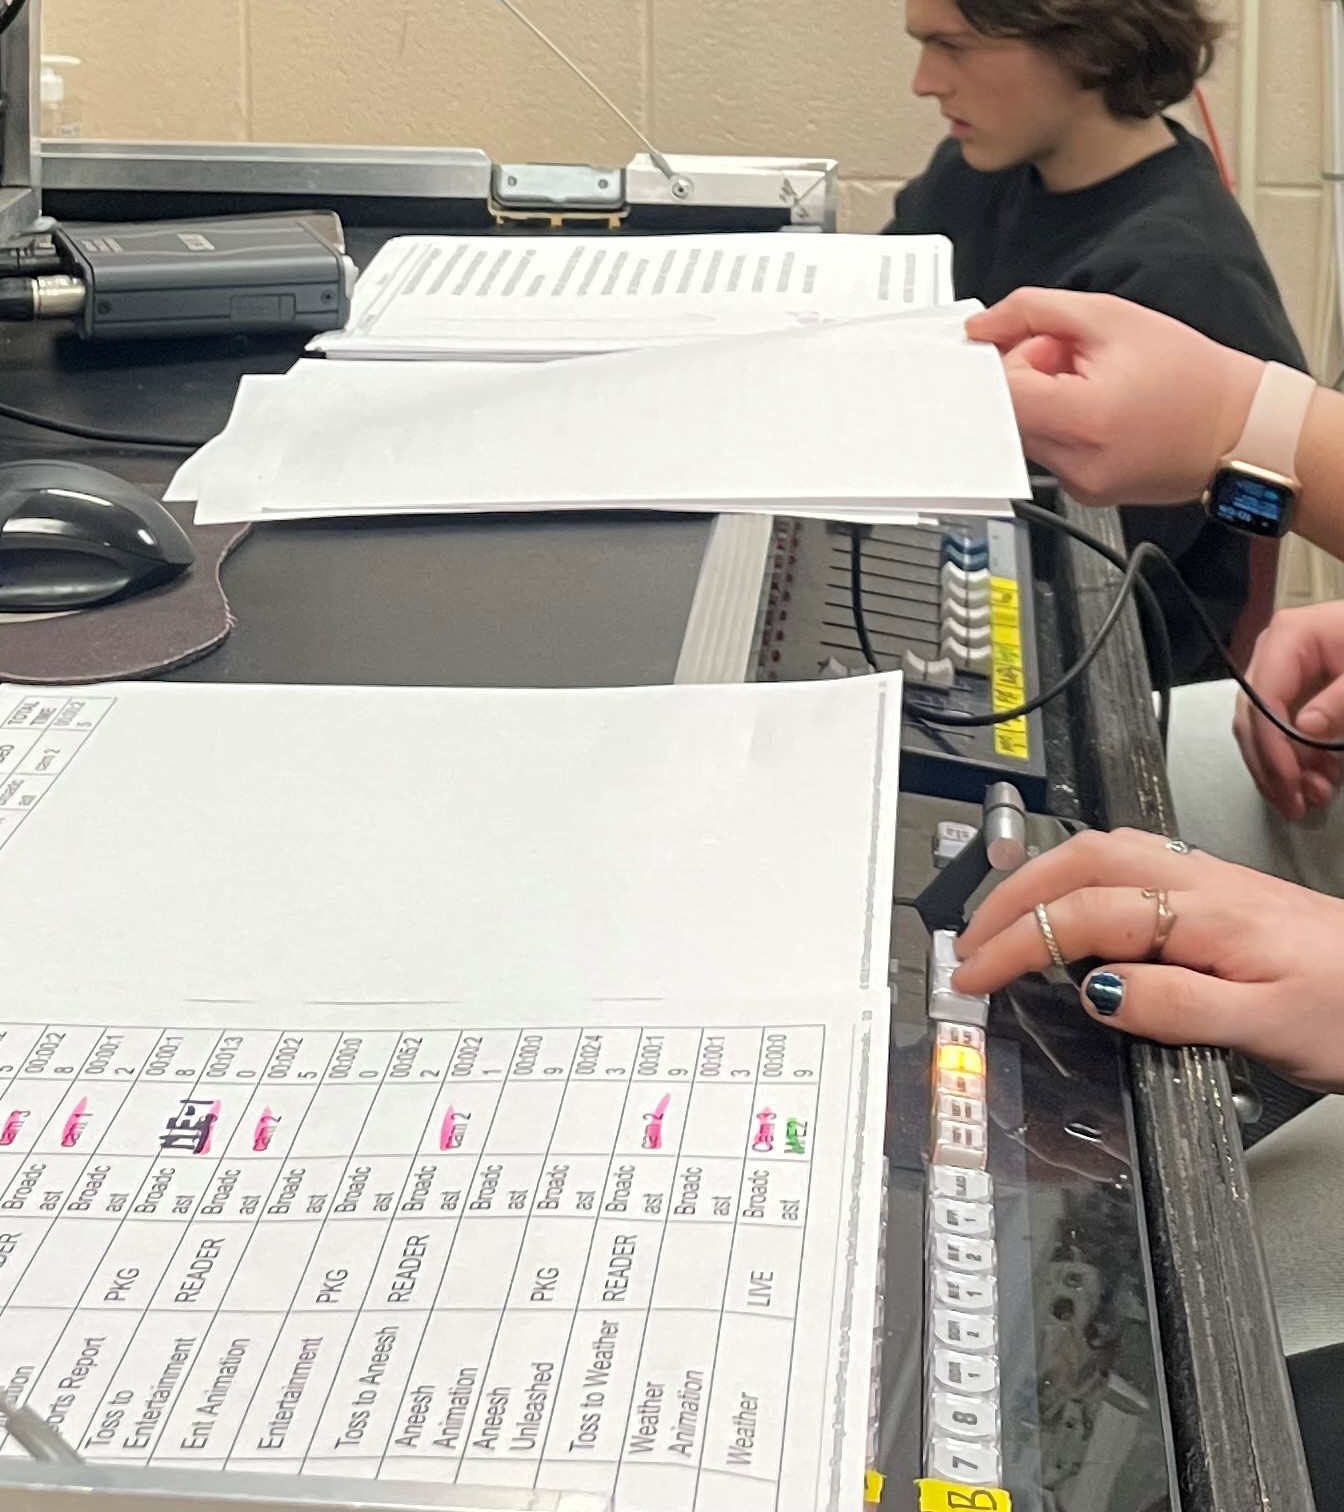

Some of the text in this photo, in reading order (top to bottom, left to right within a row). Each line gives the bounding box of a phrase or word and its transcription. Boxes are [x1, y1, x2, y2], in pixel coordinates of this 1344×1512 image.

[8, 701, 40, 726] TOTAL
[54, 1066, 74, 1074] 8
[1, 1163, 46, 1210] Broadc
[39, 1190, 64, 1210] ast
[201, 1168, 241, 1215] Broadc
[239, 1194, 262, 1214] ast
[469, 1164, 504, 1210] Broadc
[507, 1189, 528, 1210] ast
[743, 1169, 770, 1218] Broadc
[781, 1199, 800, 1220] ast
[104, 1267, 139, 1301] PKG
[174, 1237, 225, 1303] READER
[316, 1268, 348, 1303] PKG
[387, 1234, 430, 1303] READER
[530, 1266, 560, 1302] PKG
[602, 1233, 637, 1302] READER
[747, 1270, 773, 1307] LIVE
[58, 1336, 106, 1389] Report
[334, 1325, 399, 1450] Toss to Aneesh
[568, 1319, 619, 1453] Toss to Weather
[84, 1389, 135, 1448] Toss to
[122, 1337, 197, 1449] Entertainment
[180, 1338, 251, 1449] Ent Animation
[257, 1336, 323, 1450] Entertainment
[394, 1384, 436, 1449] Aneesh
[432, 1367, 479, 1450] Animation
[472, 1385, 511, 1451] Aneesh
[509, 1361, 554, 1451] Unleashed
[628, 1381, 665, 1455] Weather
[668, 1369, 704, 1458] Animation
[951, 1411, 978, 1426] 8
[726, 1391, 759, 1466] Weather
[951, 1456, 979, 1470] 7
[947, 1488, 998, 1511] B
